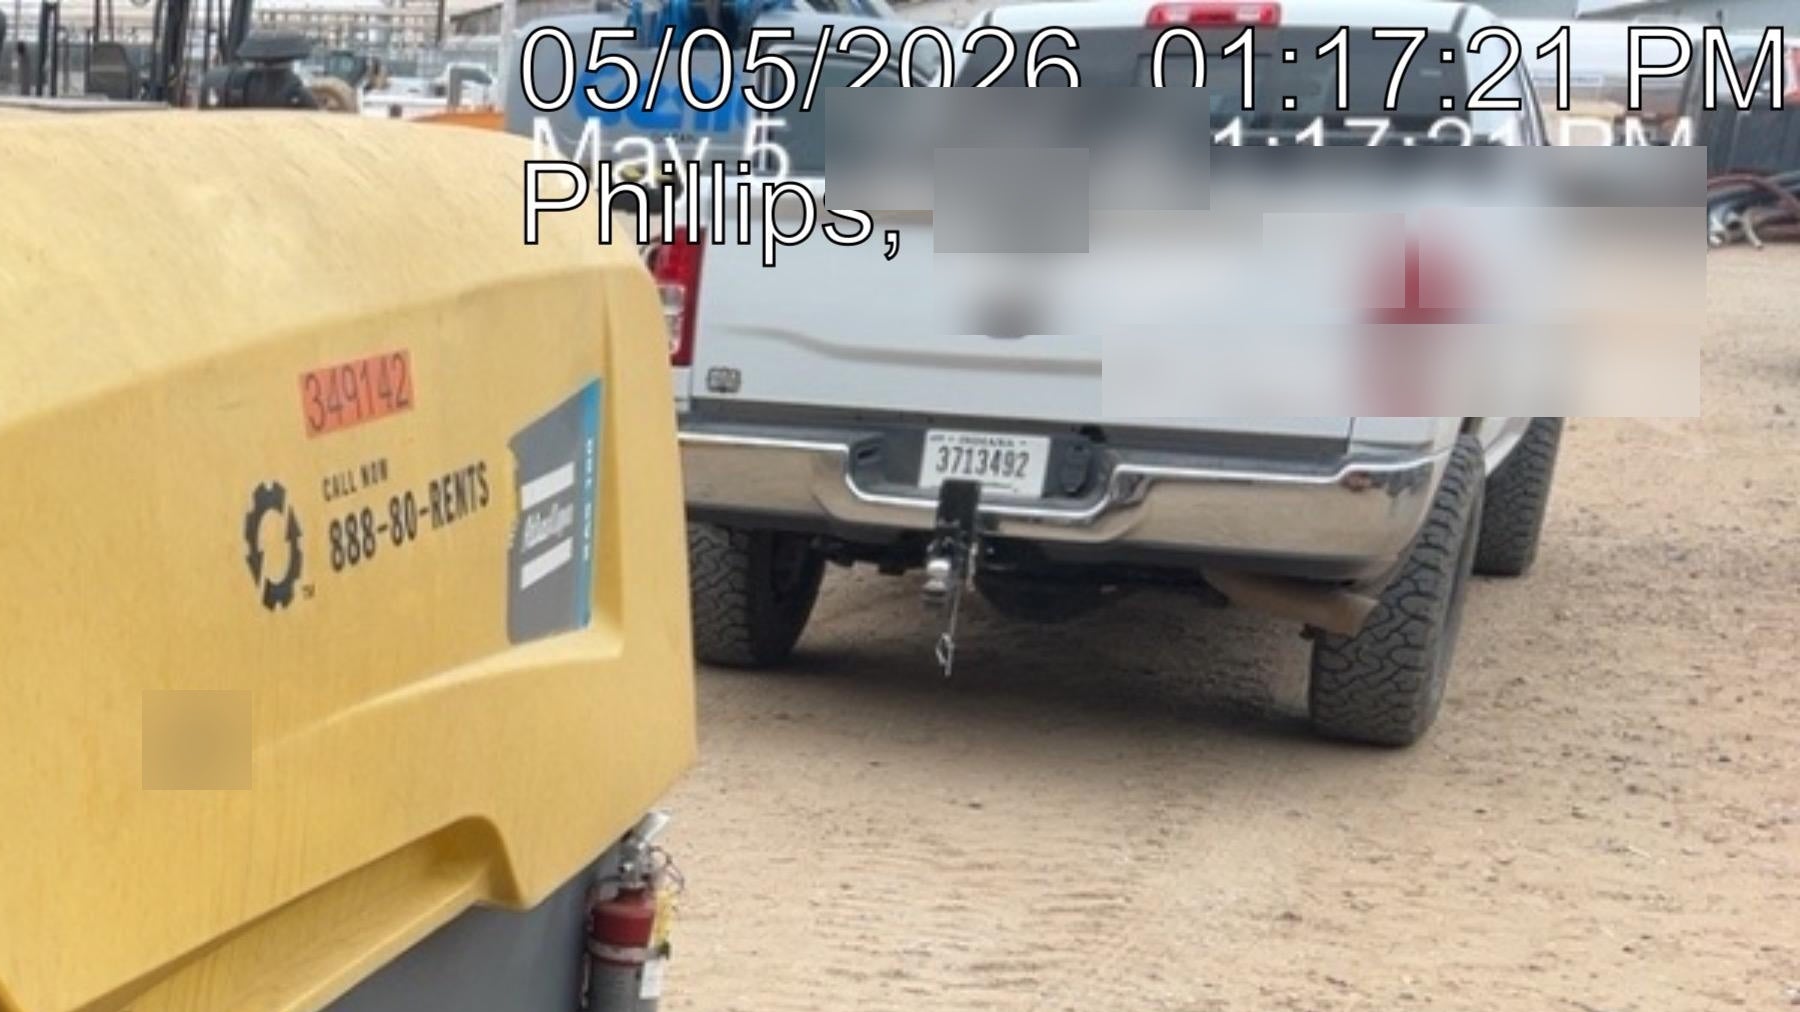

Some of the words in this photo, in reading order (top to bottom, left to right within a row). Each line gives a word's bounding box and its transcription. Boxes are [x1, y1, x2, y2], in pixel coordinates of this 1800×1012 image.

[304, 352, 410, 432] 349142
[322, 470, 357, 502] CALL
[360, 457, 388, 488] NOW
[935, 445, 1030, 478] 3713492
[328, 460, 490, 573] 888-80-RENTS
